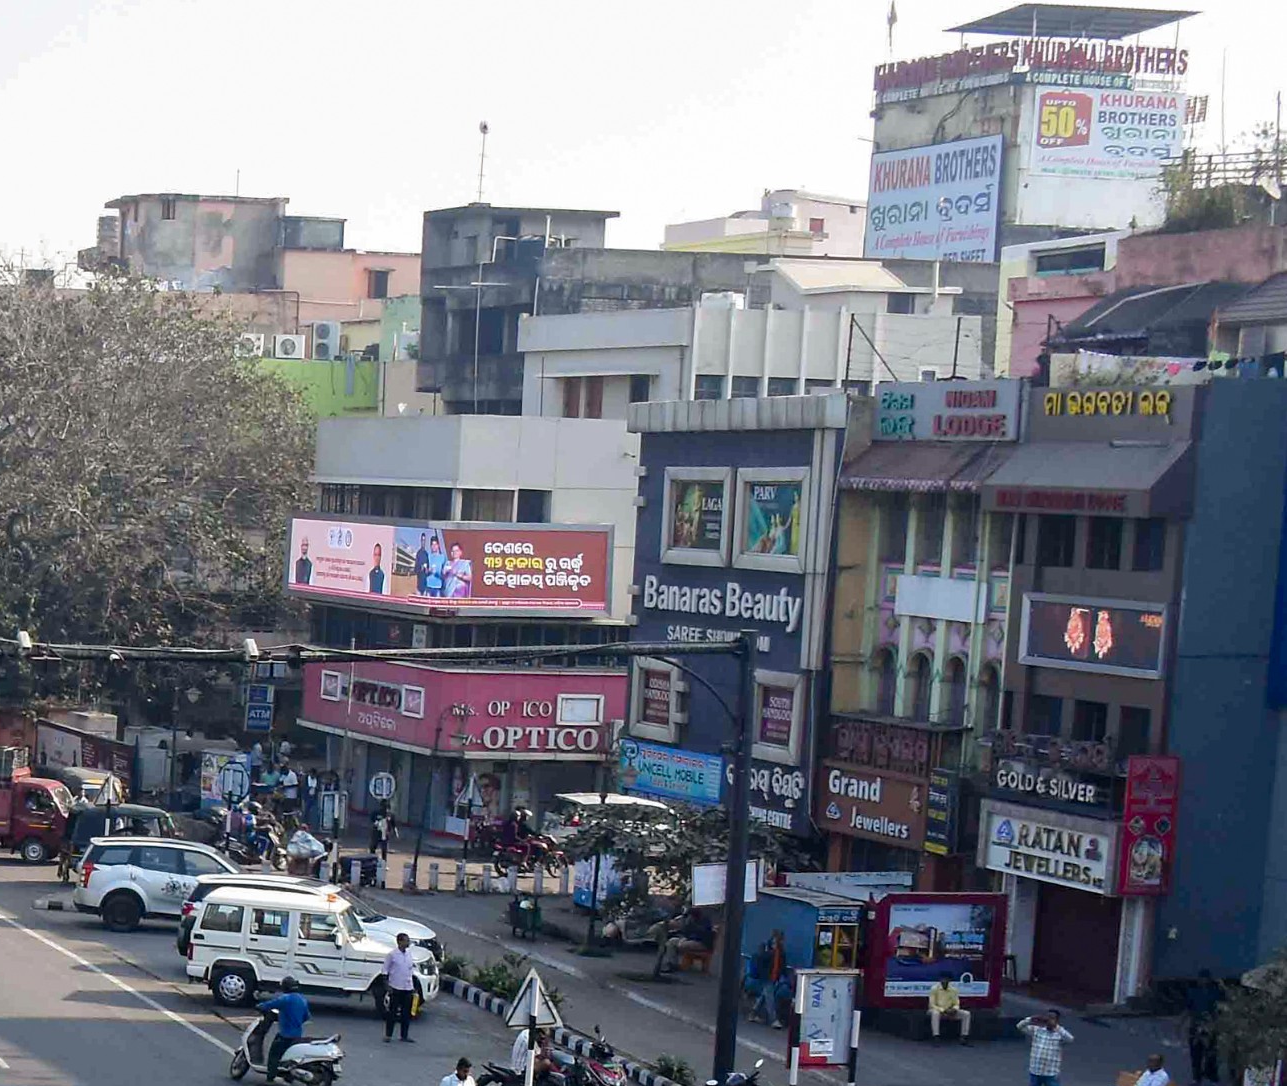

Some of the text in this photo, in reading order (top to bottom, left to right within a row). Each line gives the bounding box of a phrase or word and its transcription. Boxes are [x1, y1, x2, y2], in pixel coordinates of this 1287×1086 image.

[1103, 40, 1190, 76] BROTHERS
[1033, 73, 1080, 86] COMPLETE
[1082, 74, 1111, 87] HOUSE
[1113, 77, 1126, 88] OF
[1045, 99, 1077, 107] UPTO
[1099, 94, 1178, 110] KHURANA
[1098, 111, 1177, 127] BROTHERS
[1039, 138, 1065, 146] OFF
[873, 144, 997, 193] KHURANA BROTHERS
[1043, 393, 1062, 416] ମା
[932, 415, 1007, 437] LODGE
[644, 575, 802, 633] Banaras Beauty
[667, 625, 703, 642] SAREE
[248, 709, 271, 719] ATM
[482, 727, 599, 750] OPTICO
[638, 760, 705, 785] UNICELL MOBILE
[828, 769, 883, 804] Grand
[996, 769, 1096, 803] GOLD & SILVER
[849, 806, 909, 839] Jewellers
[1017, 823, 1085, 858] RATAN
[1004, 850, 1092, 886] JEWELLERS
